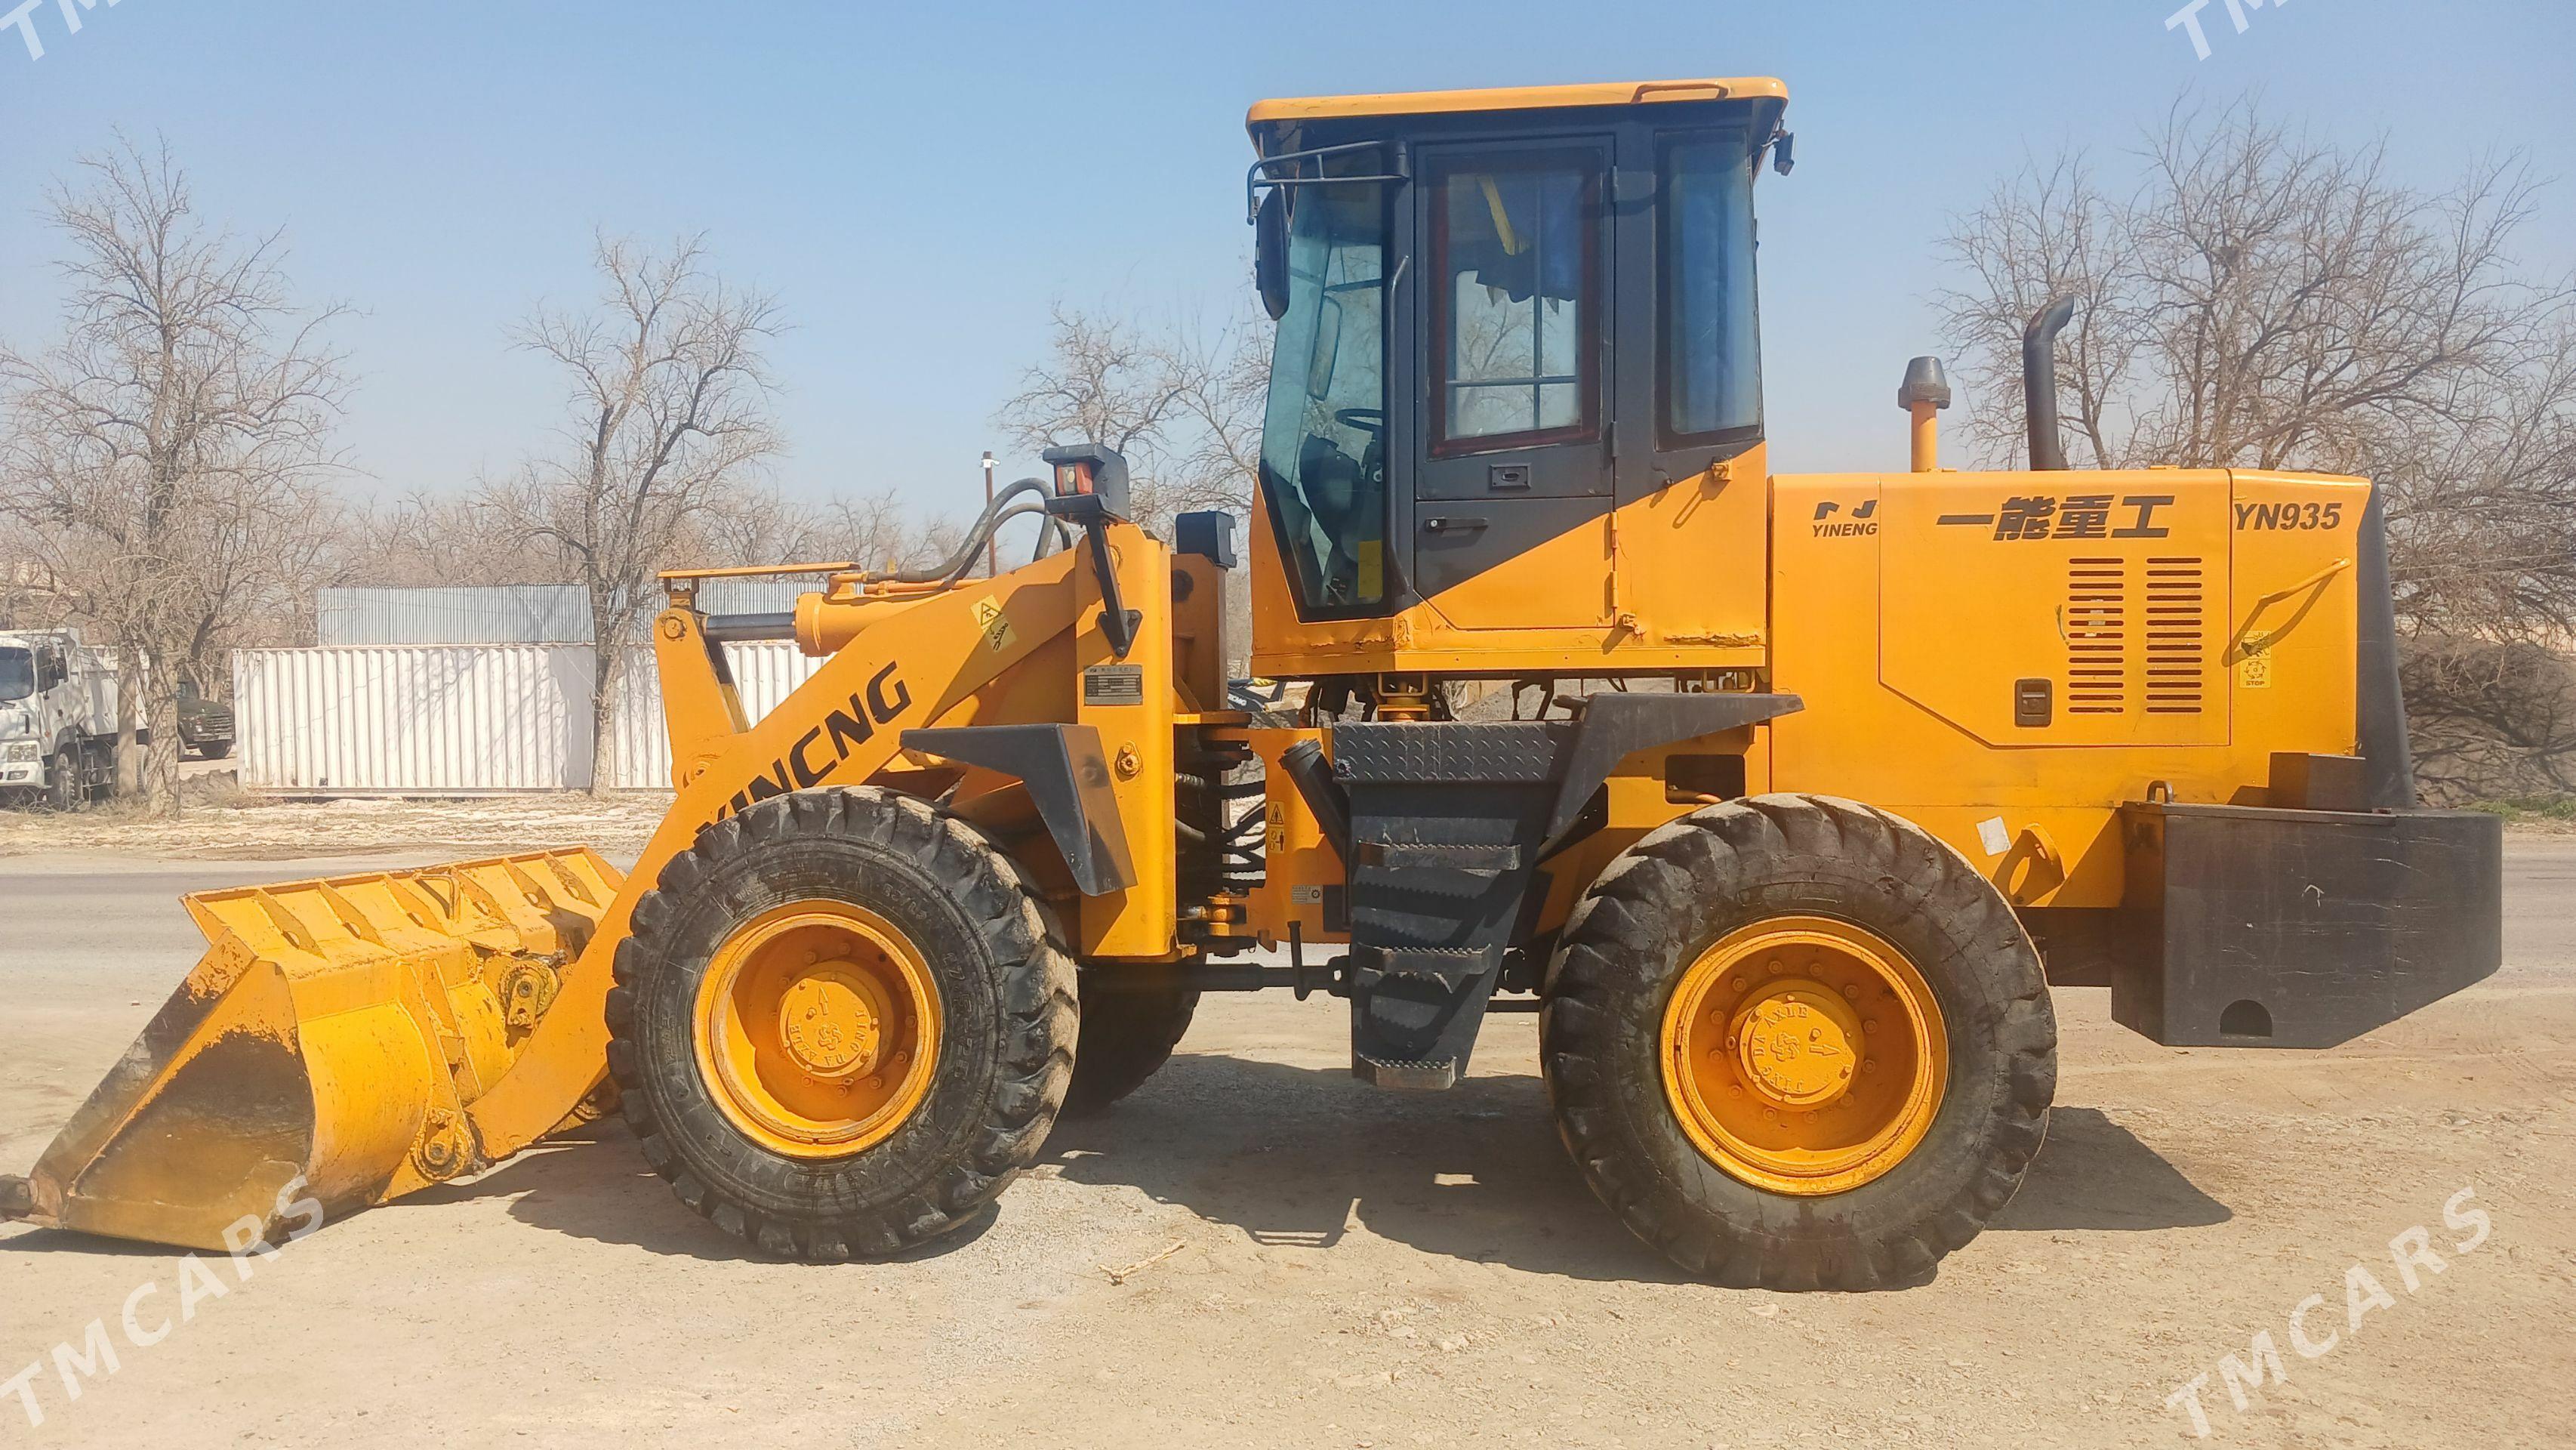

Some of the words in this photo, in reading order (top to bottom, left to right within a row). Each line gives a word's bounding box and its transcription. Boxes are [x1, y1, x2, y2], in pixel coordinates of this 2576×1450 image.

[1812, 523, 1878, 538] YINENG
[1935, 494, 2176, 541] 一能重工
[2234, 502, 2343, 531] YN935
